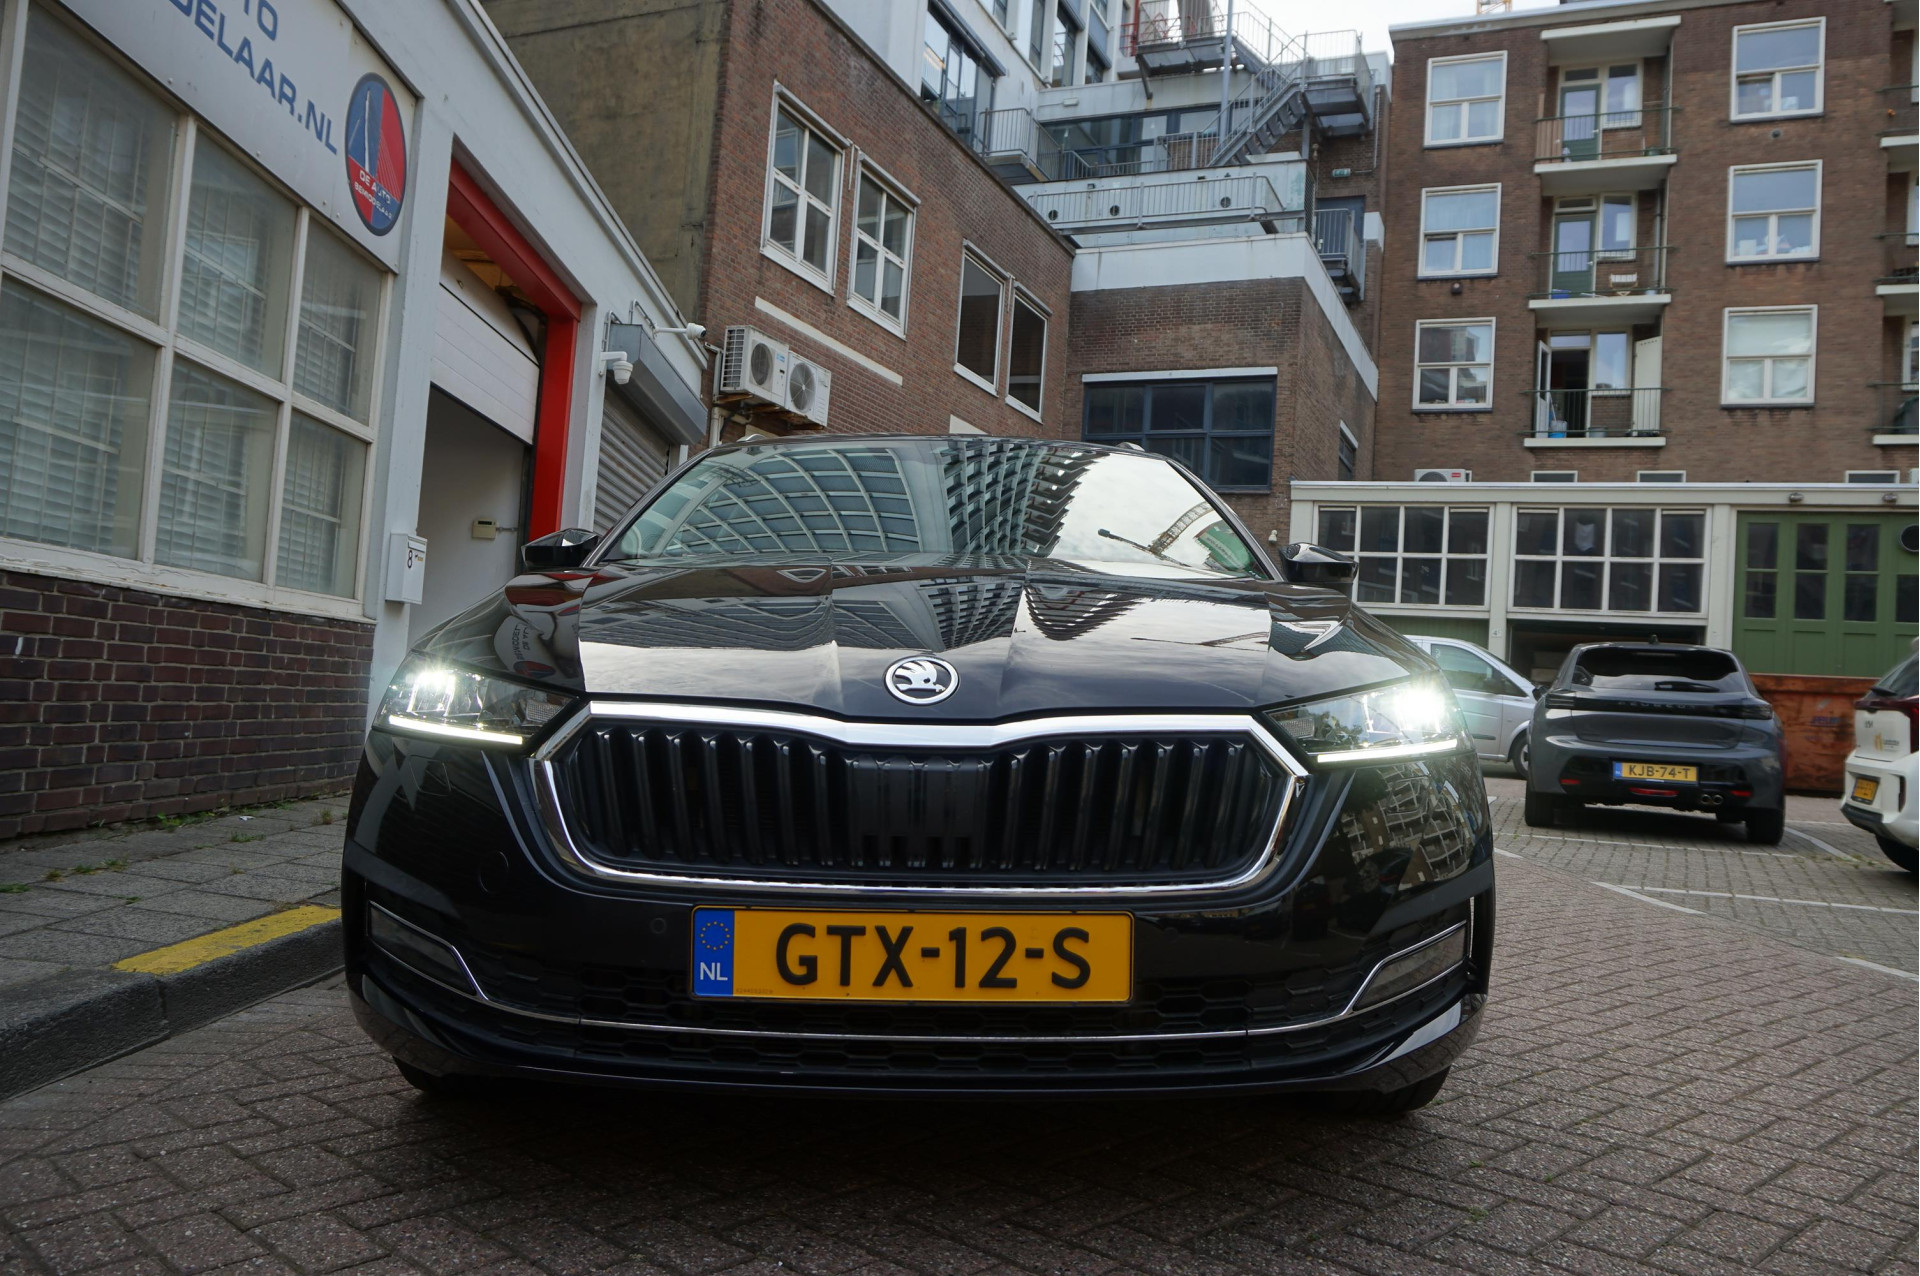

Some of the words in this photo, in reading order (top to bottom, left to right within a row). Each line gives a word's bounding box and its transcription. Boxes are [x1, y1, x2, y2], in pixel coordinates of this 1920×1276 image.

[359, 168, 371, 188] DE
[1628, 764, 1691, 780] KJB-74-T
[775, 922, 1092, 990] GTX-12-S
[699, 961, 729, 982] NL
